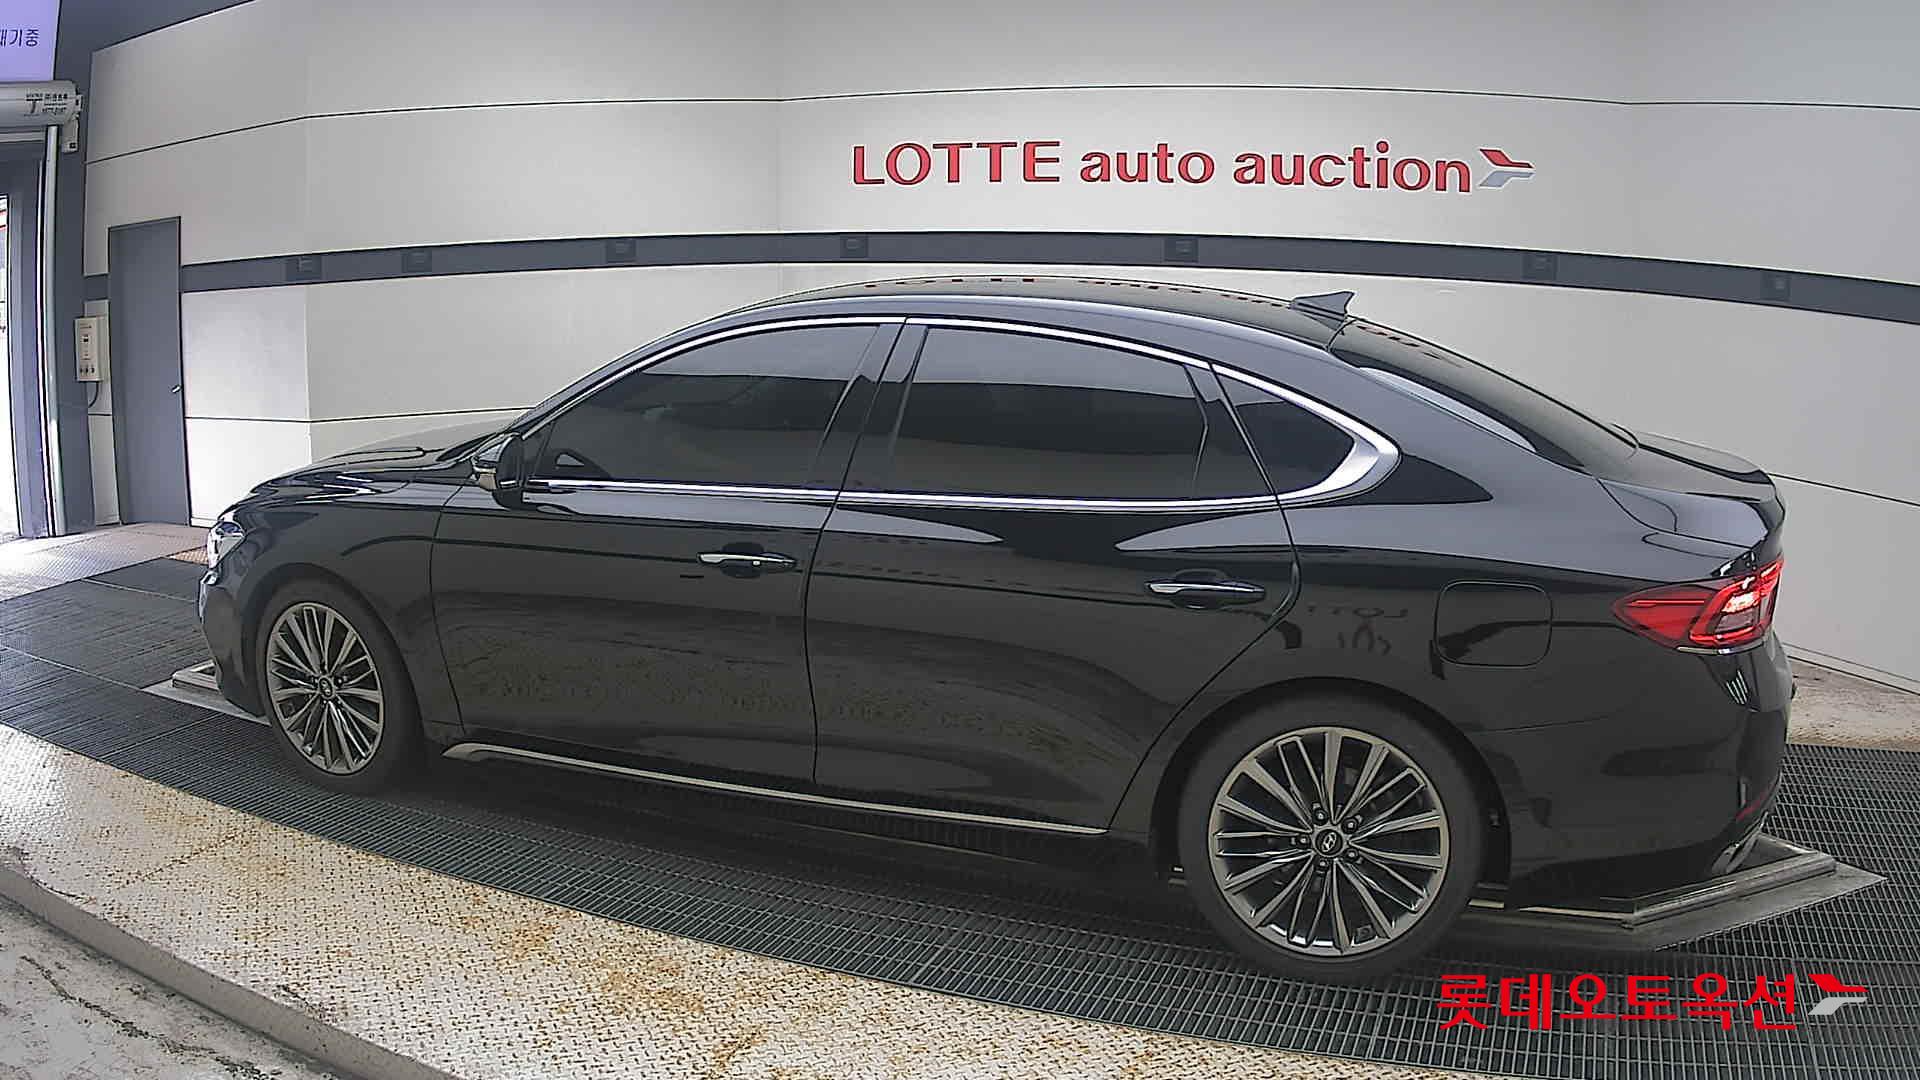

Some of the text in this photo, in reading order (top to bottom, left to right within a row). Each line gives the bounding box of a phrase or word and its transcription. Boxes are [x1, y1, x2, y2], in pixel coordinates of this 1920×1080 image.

[853, 140, 1472, 193] LOTTE auto auction
